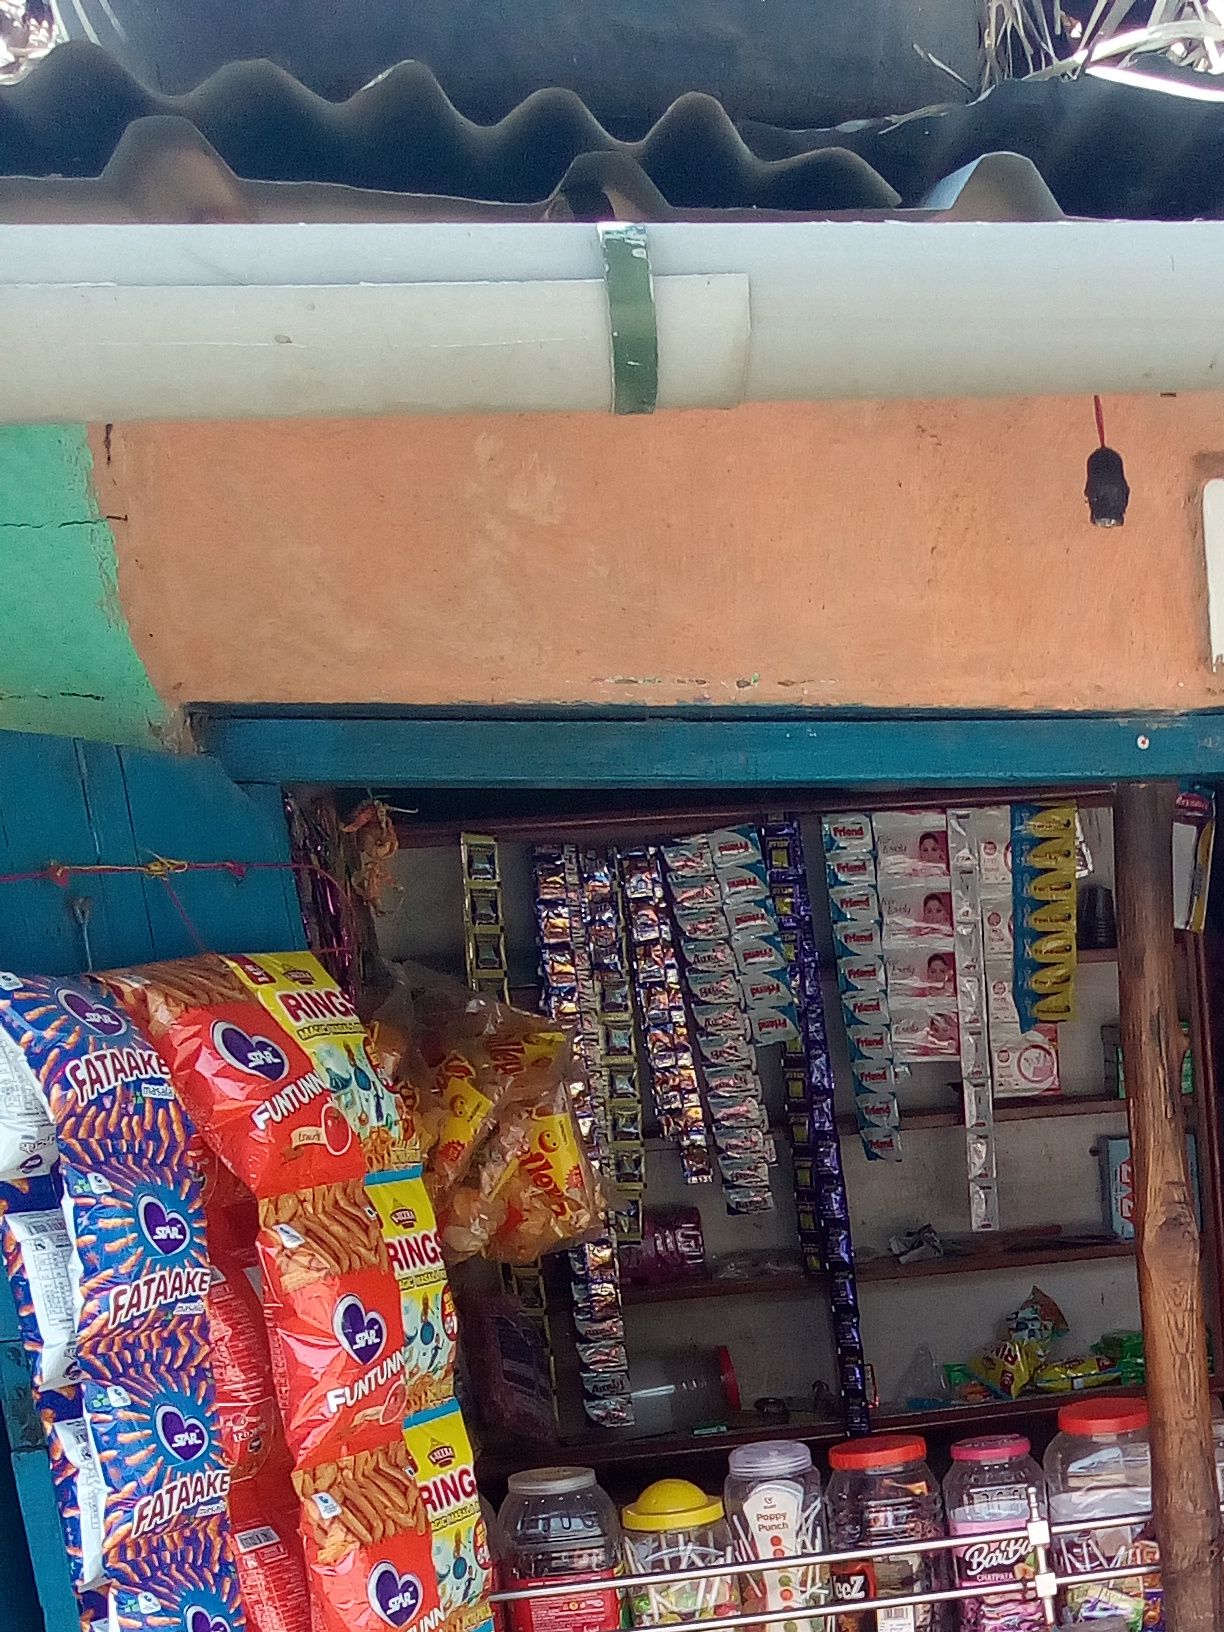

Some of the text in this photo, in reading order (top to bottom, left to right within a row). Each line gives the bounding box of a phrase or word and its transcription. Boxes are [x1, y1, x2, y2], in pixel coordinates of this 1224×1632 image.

[833, 827, 864, 837] Friend
[836, 862, 866, 873] Friend
[66, 1049, 172, 1106] FATAAKE
[109, 1269, 211, 1329] FATAAKE
[132, 1471, 231, 1538] FATAAKE
[756, 1512, 788, 1522] Poppy
[758, 1522, 788, 1532] Punch
